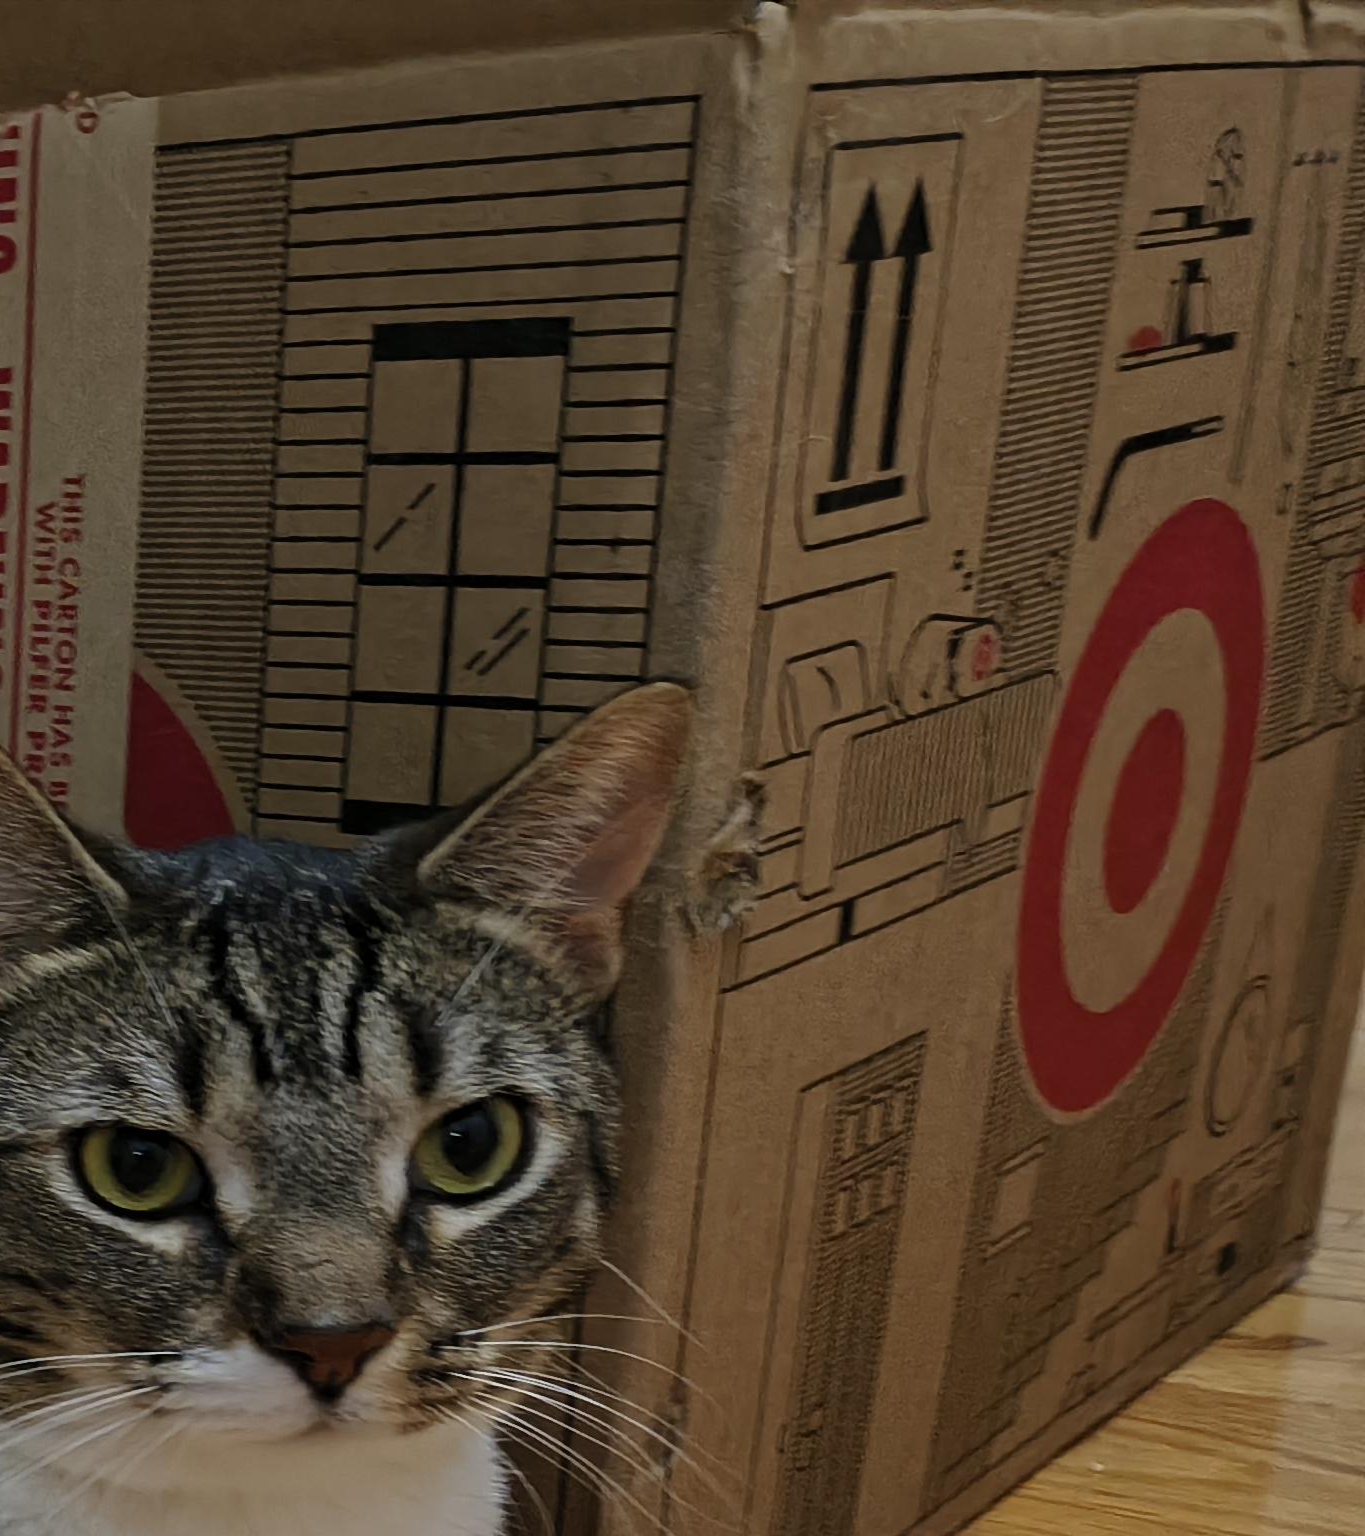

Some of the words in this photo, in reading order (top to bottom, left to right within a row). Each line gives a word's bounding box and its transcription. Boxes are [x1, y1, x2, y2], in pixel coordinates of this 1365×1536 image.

[33, 502, 57, 584] WITH
[61, 474, 86, 544] THIS
[26, 600, 53, 713] PILFER
[53, 557, 81, 692] CARTON
[48, 705, 74, 767] HAS
